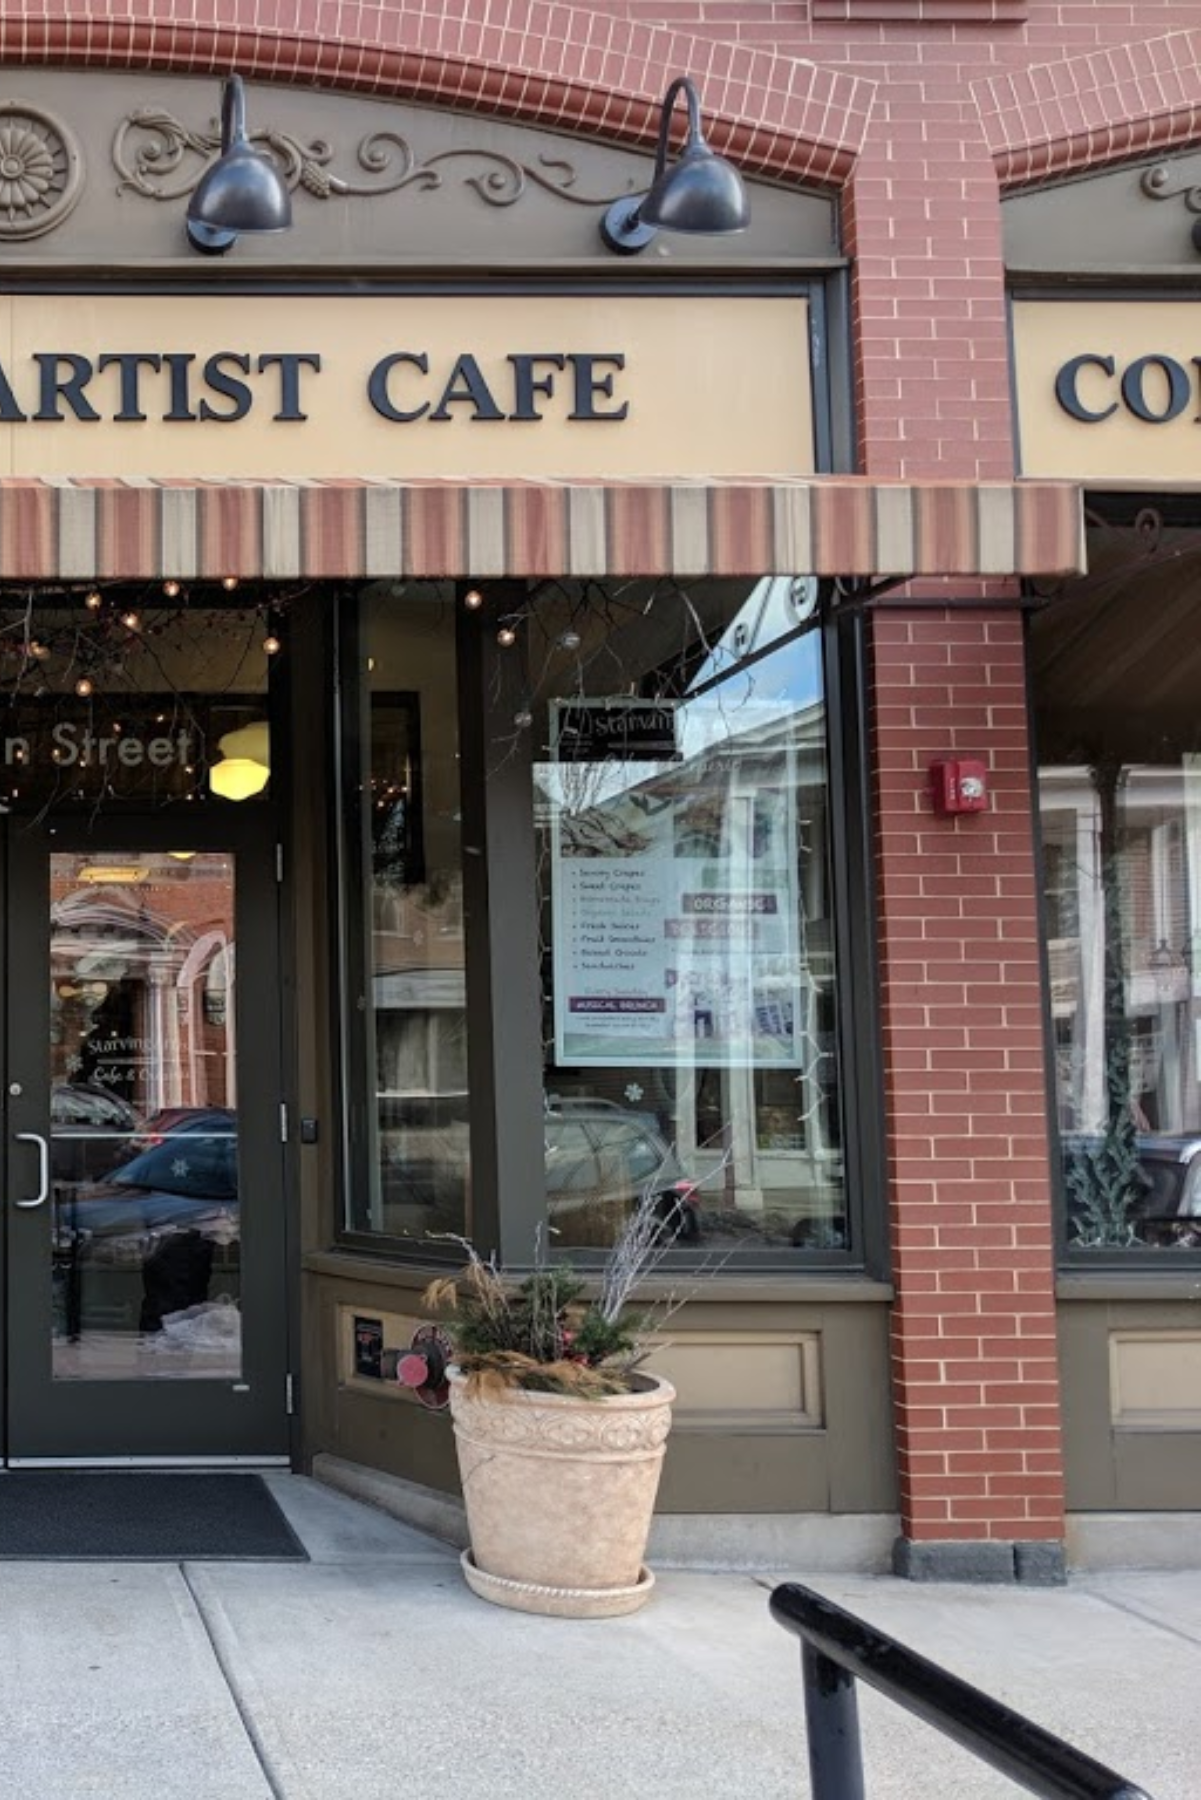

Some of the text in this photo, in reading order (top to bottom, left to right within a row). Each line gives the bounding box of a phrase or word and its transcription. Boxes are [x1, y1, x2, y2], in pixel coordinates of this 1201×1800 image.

[366, 353, 629, 423] CAFE
[1054, 354, 1201, 425] CO
[52, 722, 193, 766] Street
